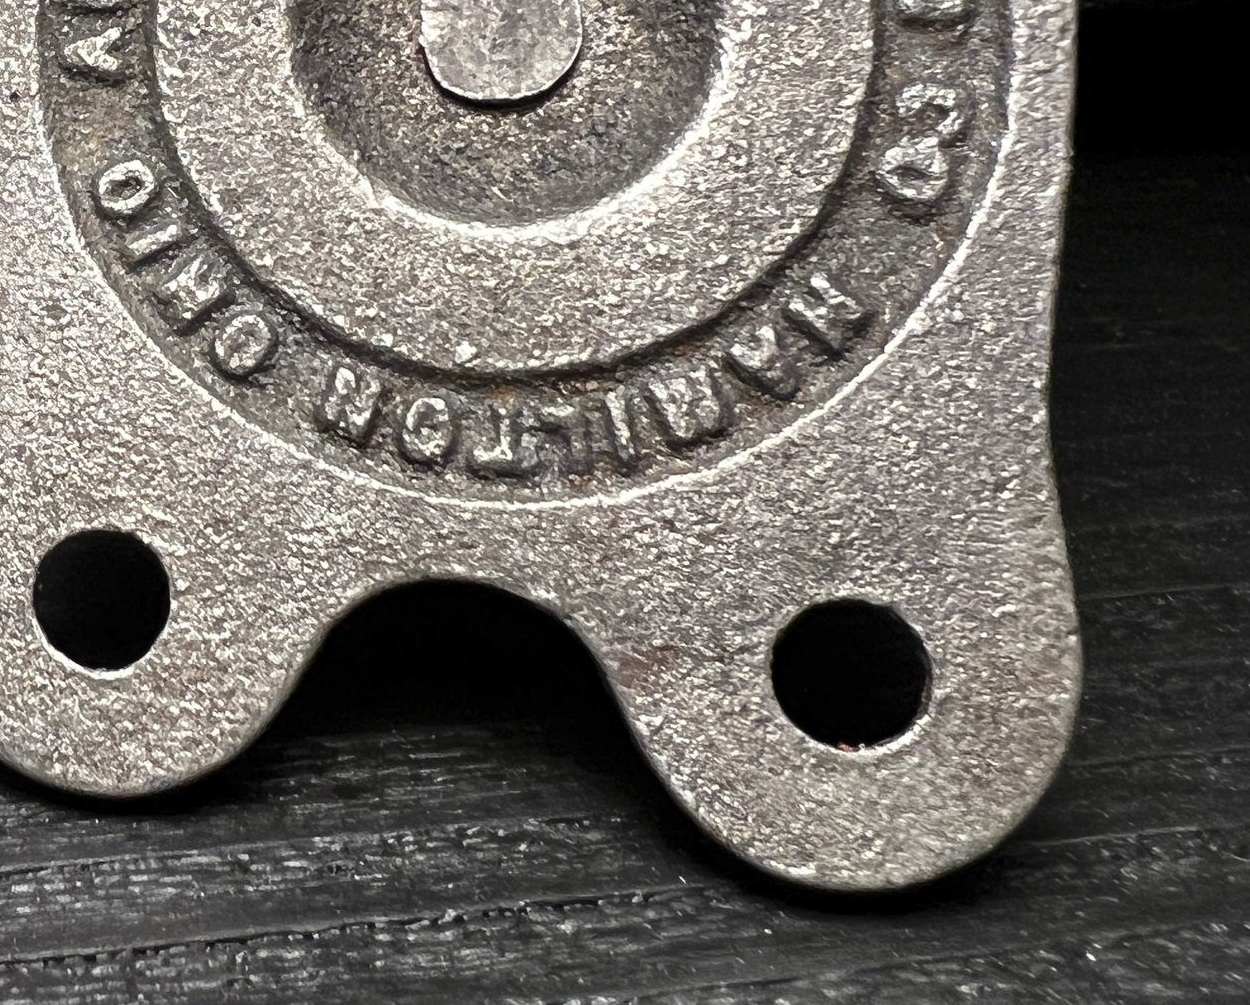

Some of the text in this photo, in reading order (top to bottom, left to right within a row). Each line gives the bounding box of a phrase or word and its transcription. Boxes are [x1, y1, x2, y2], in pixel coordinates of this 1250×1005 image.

[876, 82, 964, 204] CO
[96, 157, 277, 376] OHIO
[322, 272, 880, 469] HAMILTON
